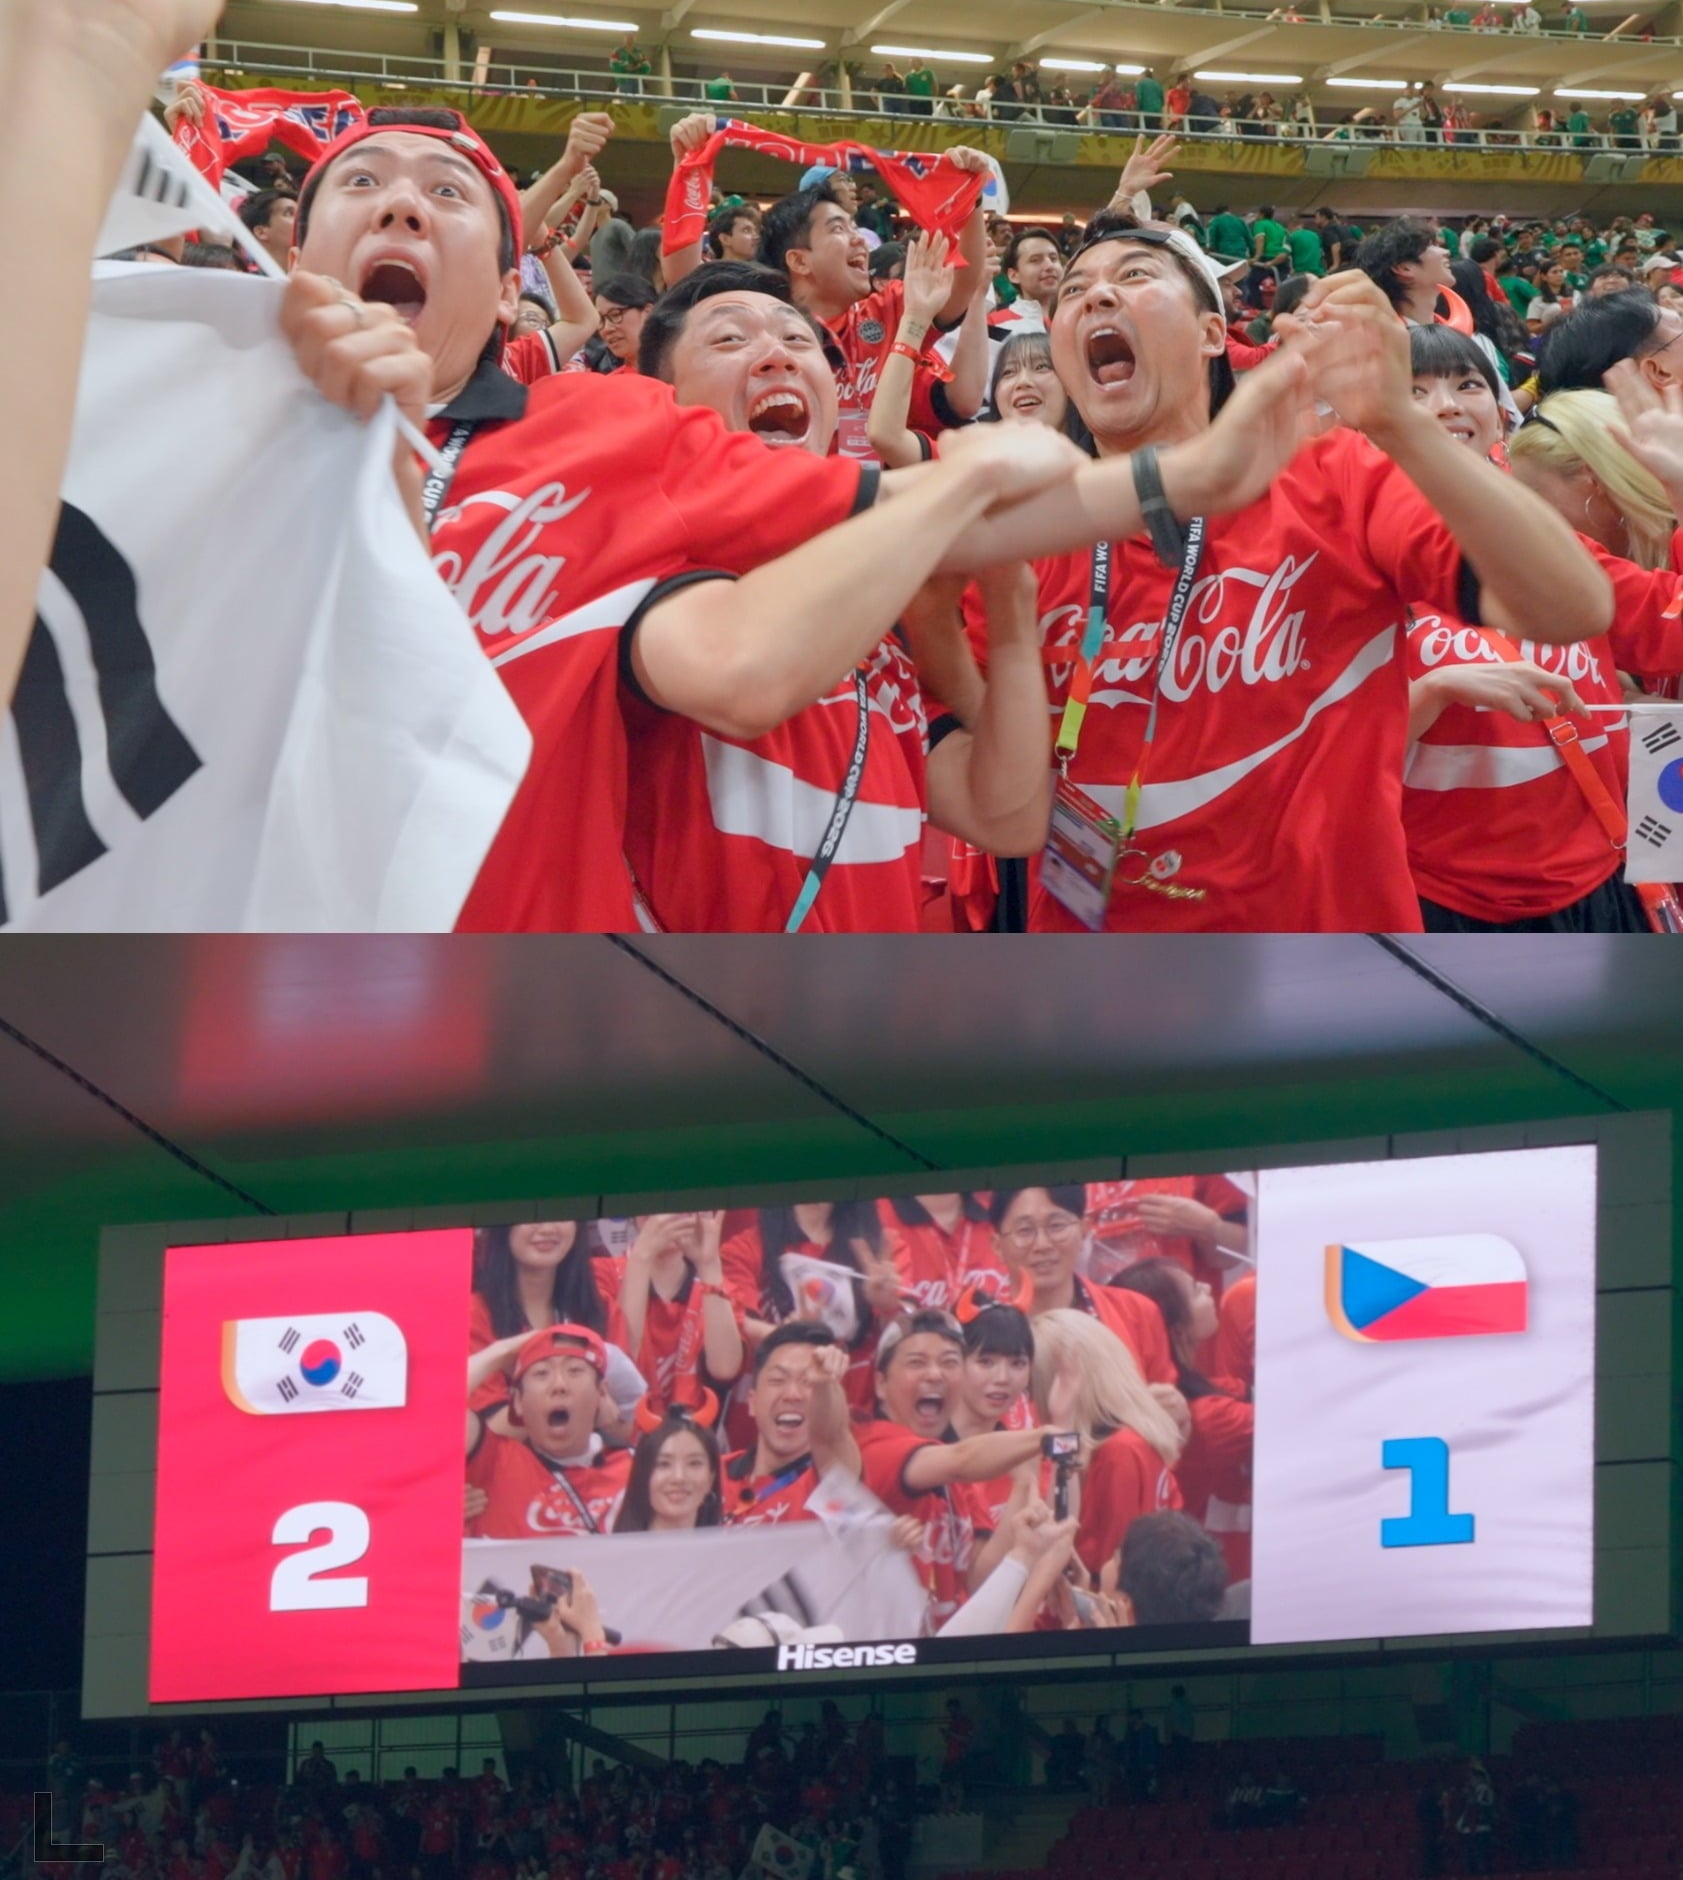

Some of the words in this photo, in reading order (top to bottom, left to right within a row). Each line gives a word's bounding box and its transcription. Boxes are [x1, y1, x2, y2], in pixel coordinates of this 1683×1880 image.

[1188, 516, 1203, 542] FIFA
[1178, 544, 1200, 593] WORLD
[1169, 593, 1186, 623] CUP
[854, 709, 868, 765] WORLD
[821, 797, 849, 858] 2026
[1380, 1436, 1475, 1549] 1
[269, 1501, 371, 1612] 2
[777, 1643, 917, 1671] Hisense
